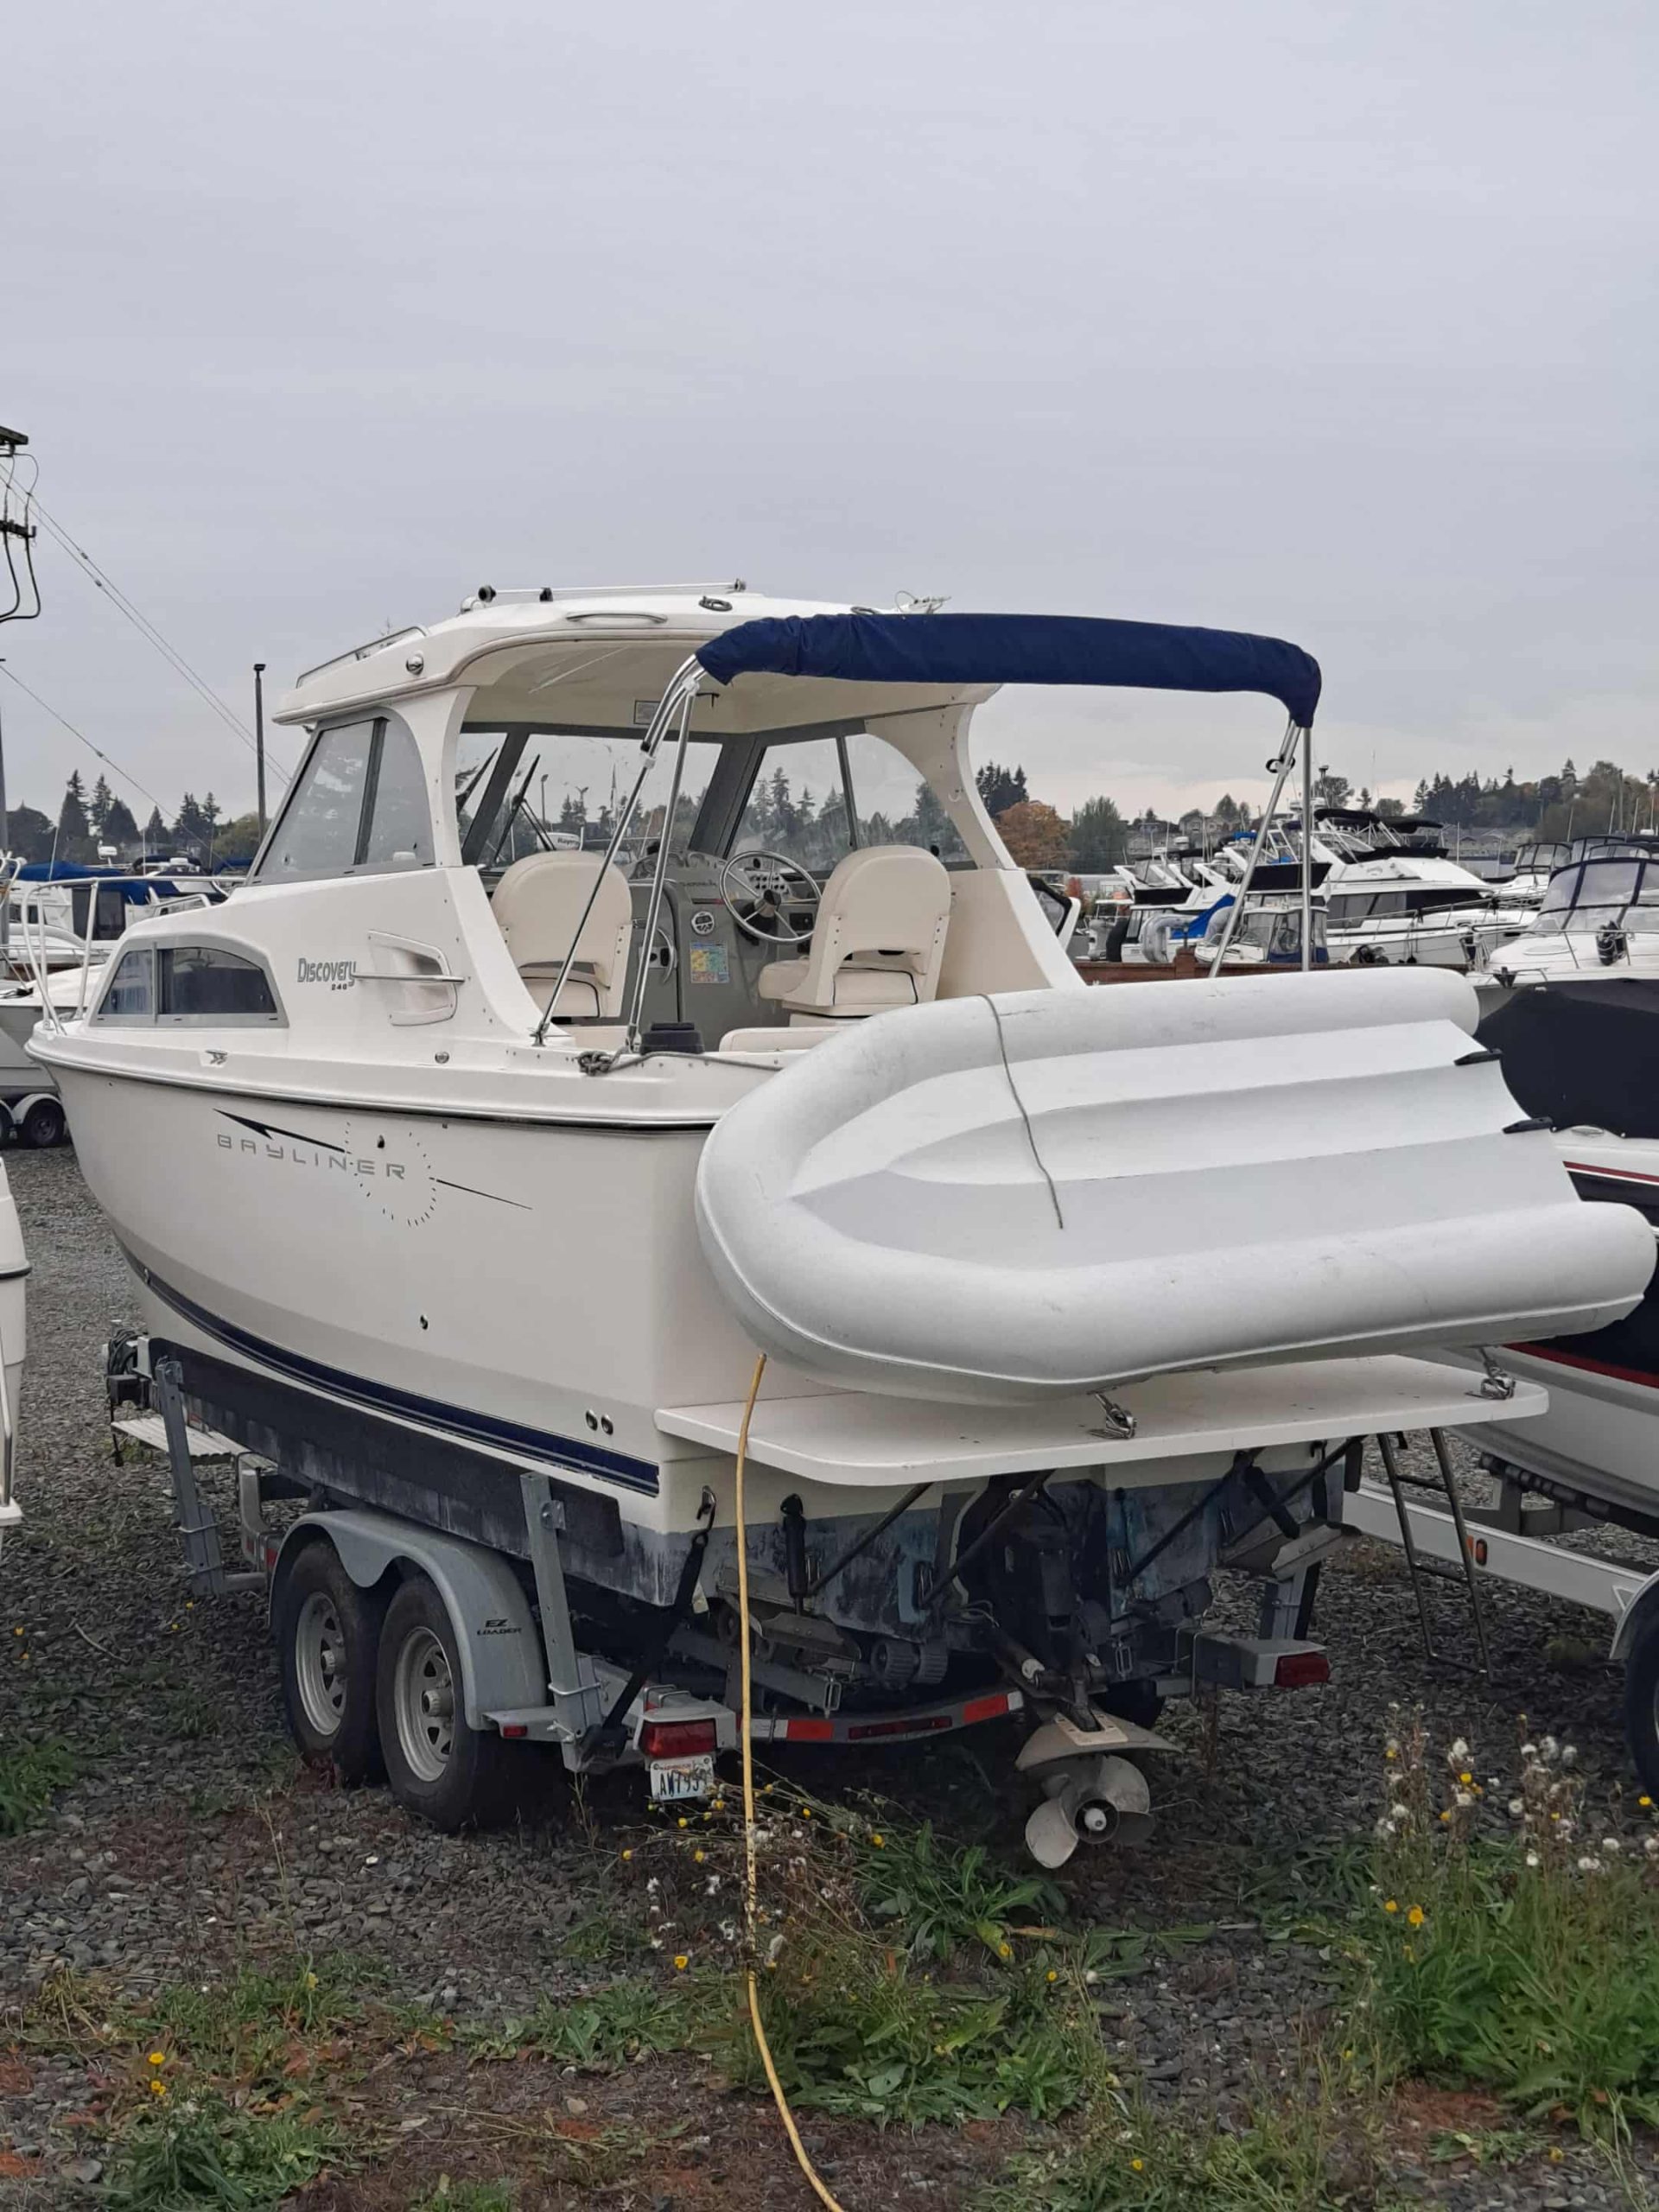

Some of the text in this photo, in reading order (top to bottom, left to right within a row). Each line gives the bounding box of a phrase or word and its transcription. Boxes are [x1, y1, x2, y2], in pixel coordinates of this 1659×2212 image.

[217, 1134, 406, 1180] BAYLINER
[485, 1618, 509, 1628] EZ
[476, 1627, 523, 1637] LOADER
